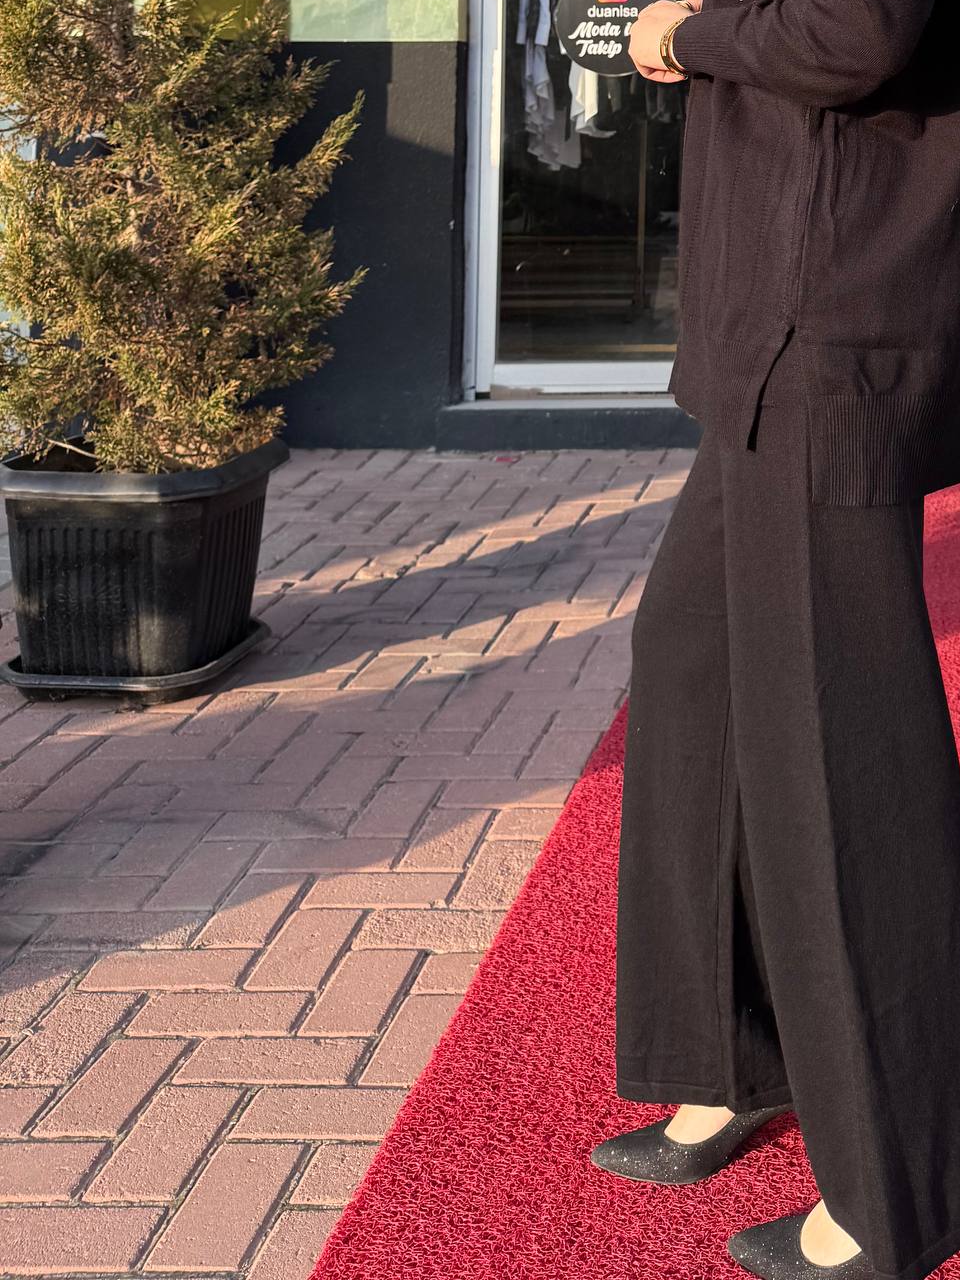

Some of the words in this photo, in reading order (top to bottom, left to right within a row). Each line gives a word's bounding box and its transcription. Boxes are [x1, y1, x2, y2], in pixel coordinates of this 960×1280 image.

[587, 5, 639, 18] duanisa
[567, 21, 621, 40] Moda
[575, 39, 623, 59] Takip
